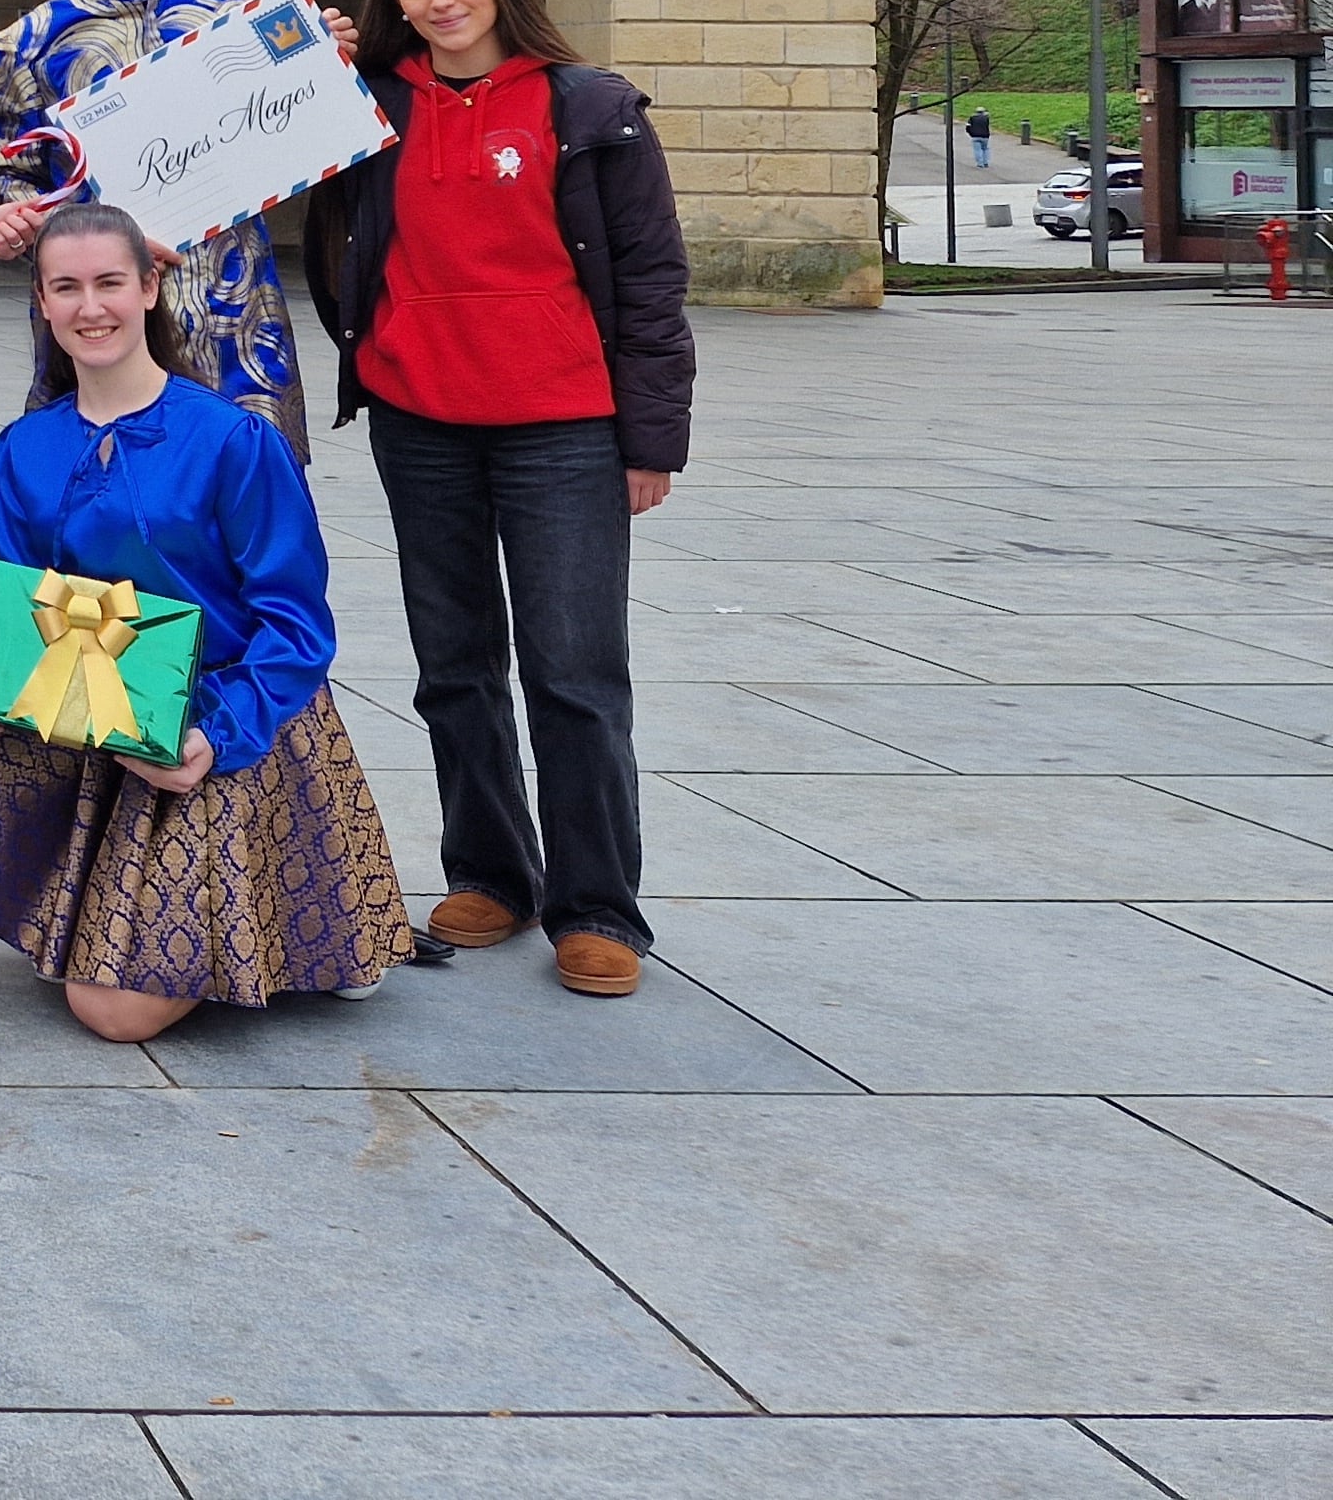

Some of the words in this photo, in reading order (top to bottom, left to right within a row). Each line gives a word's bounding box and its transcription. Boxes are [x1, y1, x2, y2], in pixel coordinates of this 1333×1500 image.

[80, 112, 94, 125] 22
[94, 99, 121, 117] MAIL
[131, 133, 215, 197] Reyes
[219, 80, 315, 144] Magos
